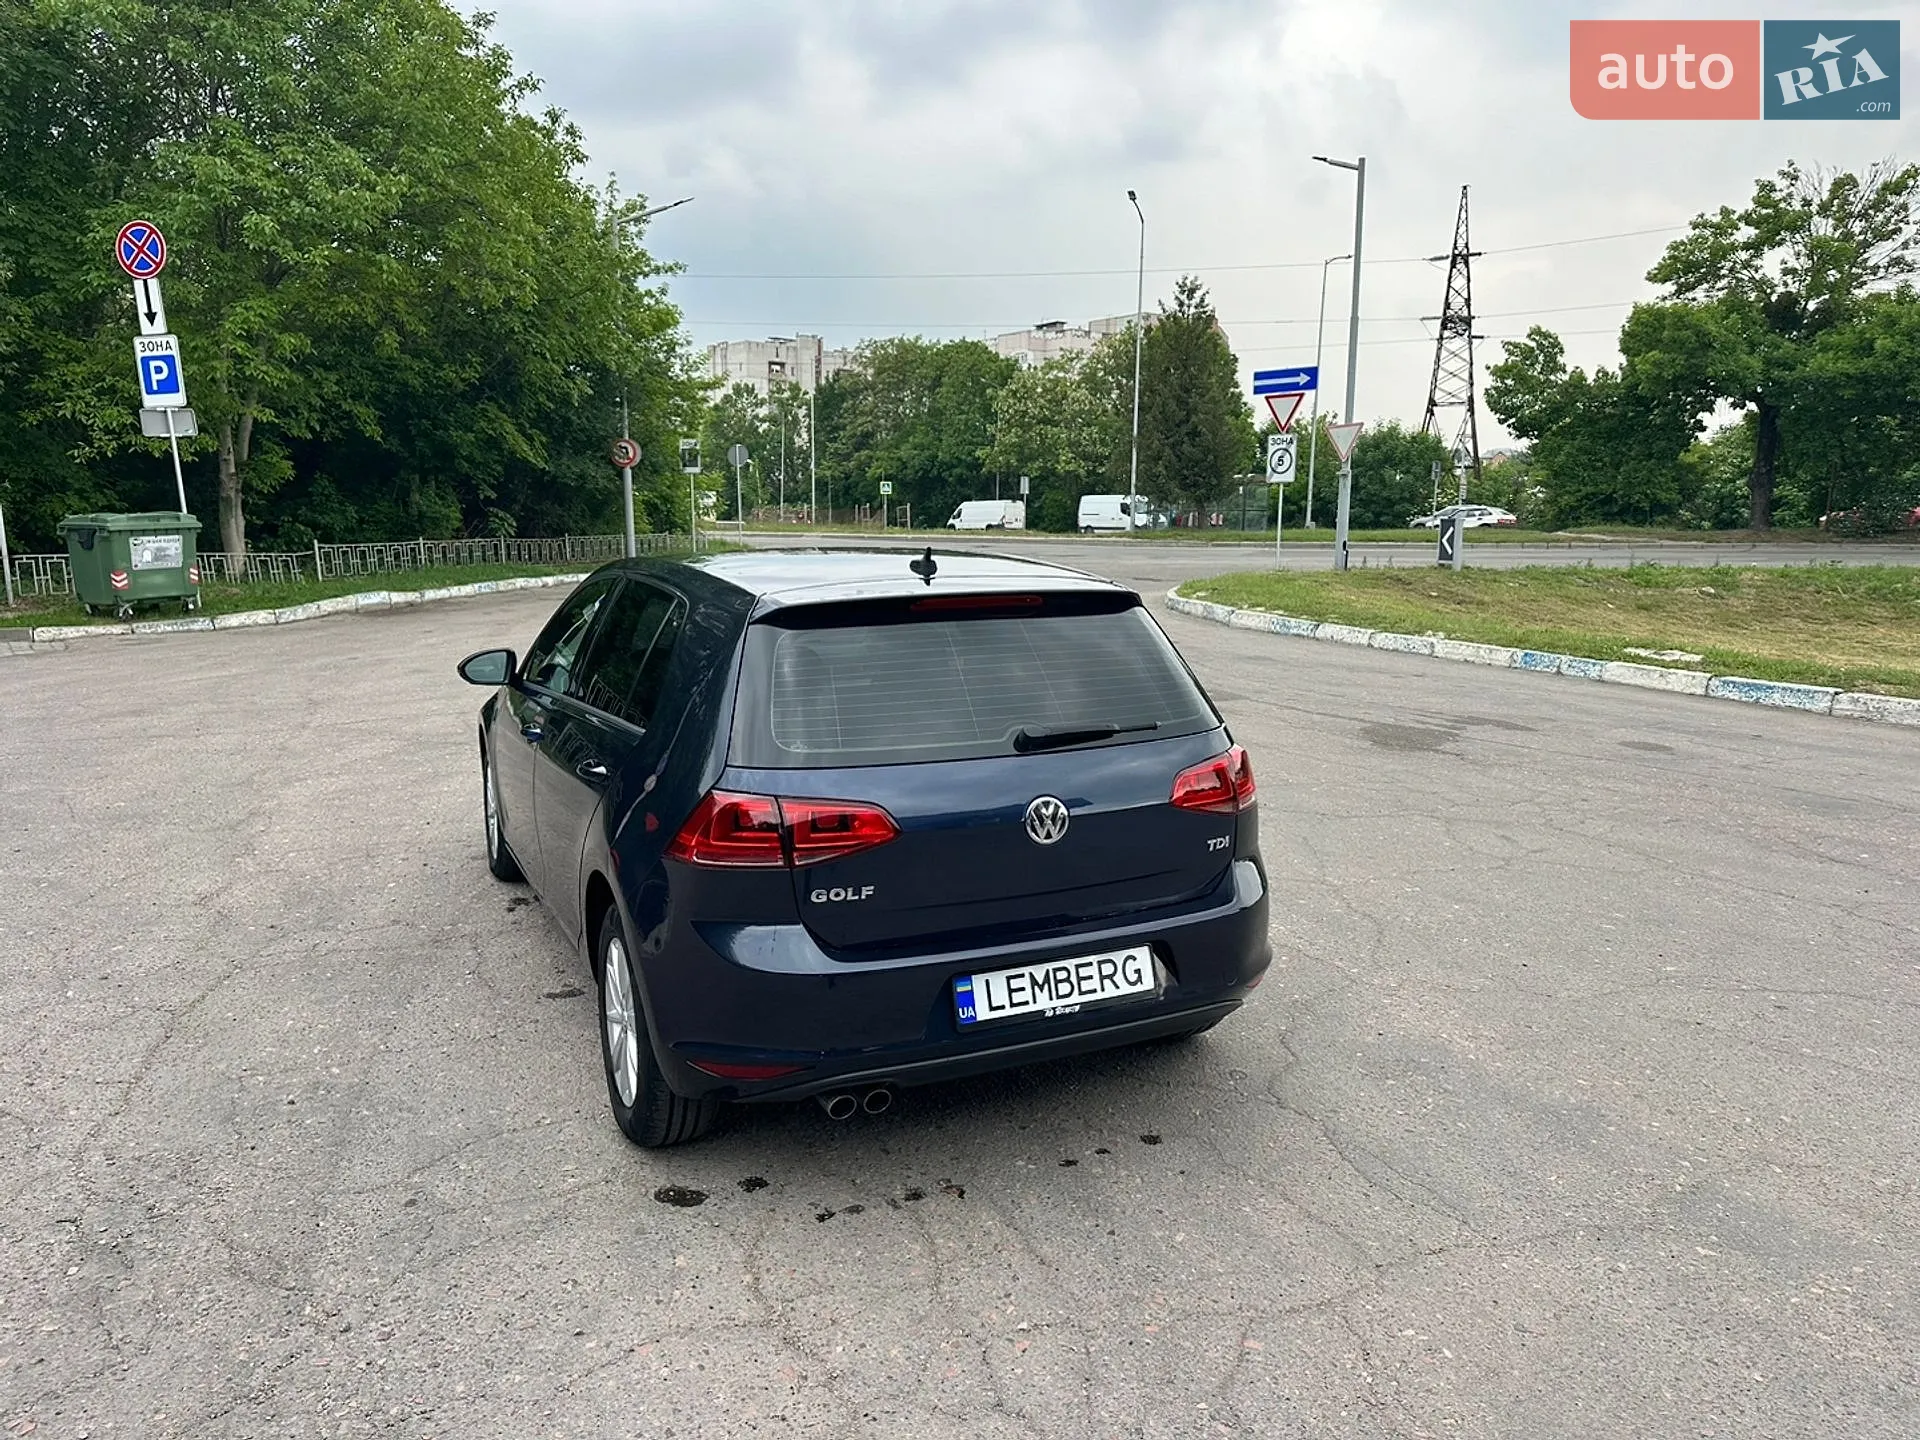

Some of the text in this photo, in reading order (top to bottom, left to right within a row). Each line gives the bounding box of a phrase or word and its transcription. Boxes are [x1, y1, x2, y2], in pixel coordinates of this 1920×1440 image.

[139, 340, 173, 353] ЗОНА
[149, 360, 169, 391] P
[1270, 437, 1294, 446] ЗОНА
[1277, 455, 1285, 467] 5
[1207, 835, 1230, 852] TDI
[810, 885, 875, 903] GOLF
[985, 954, 1143, 1012] LEMBERG
[958, 1005, 976, 1019] UA
